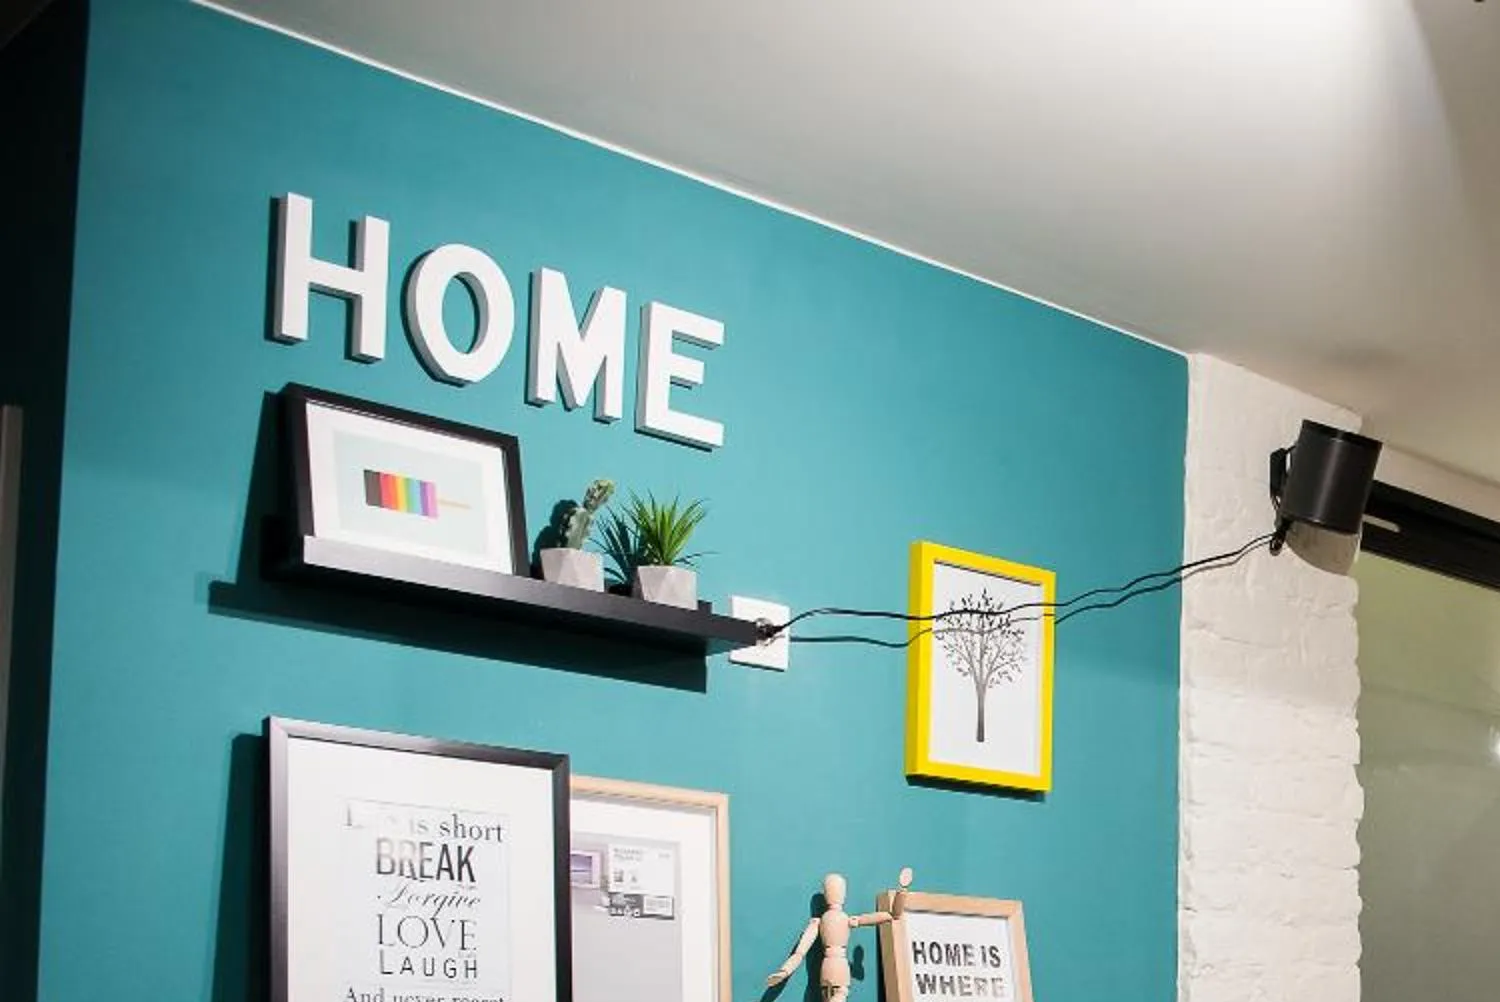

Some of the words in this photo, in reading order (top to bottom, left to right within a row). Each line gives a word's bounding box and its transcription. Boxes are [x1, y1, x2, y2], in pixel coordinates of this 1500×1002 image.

[275, 192, 724, 448] HOME
[439, 813, 503, 843] short
[376, 837, 476, 882] BREAK
[376, 914, 477, 951] LOVE
[380, 950, 477, 979] LAUGH
[912, 941, 975, 967] HOME
[981, 945, 1001, 968] IS
[915, 973, 1005, 998] WHERE
